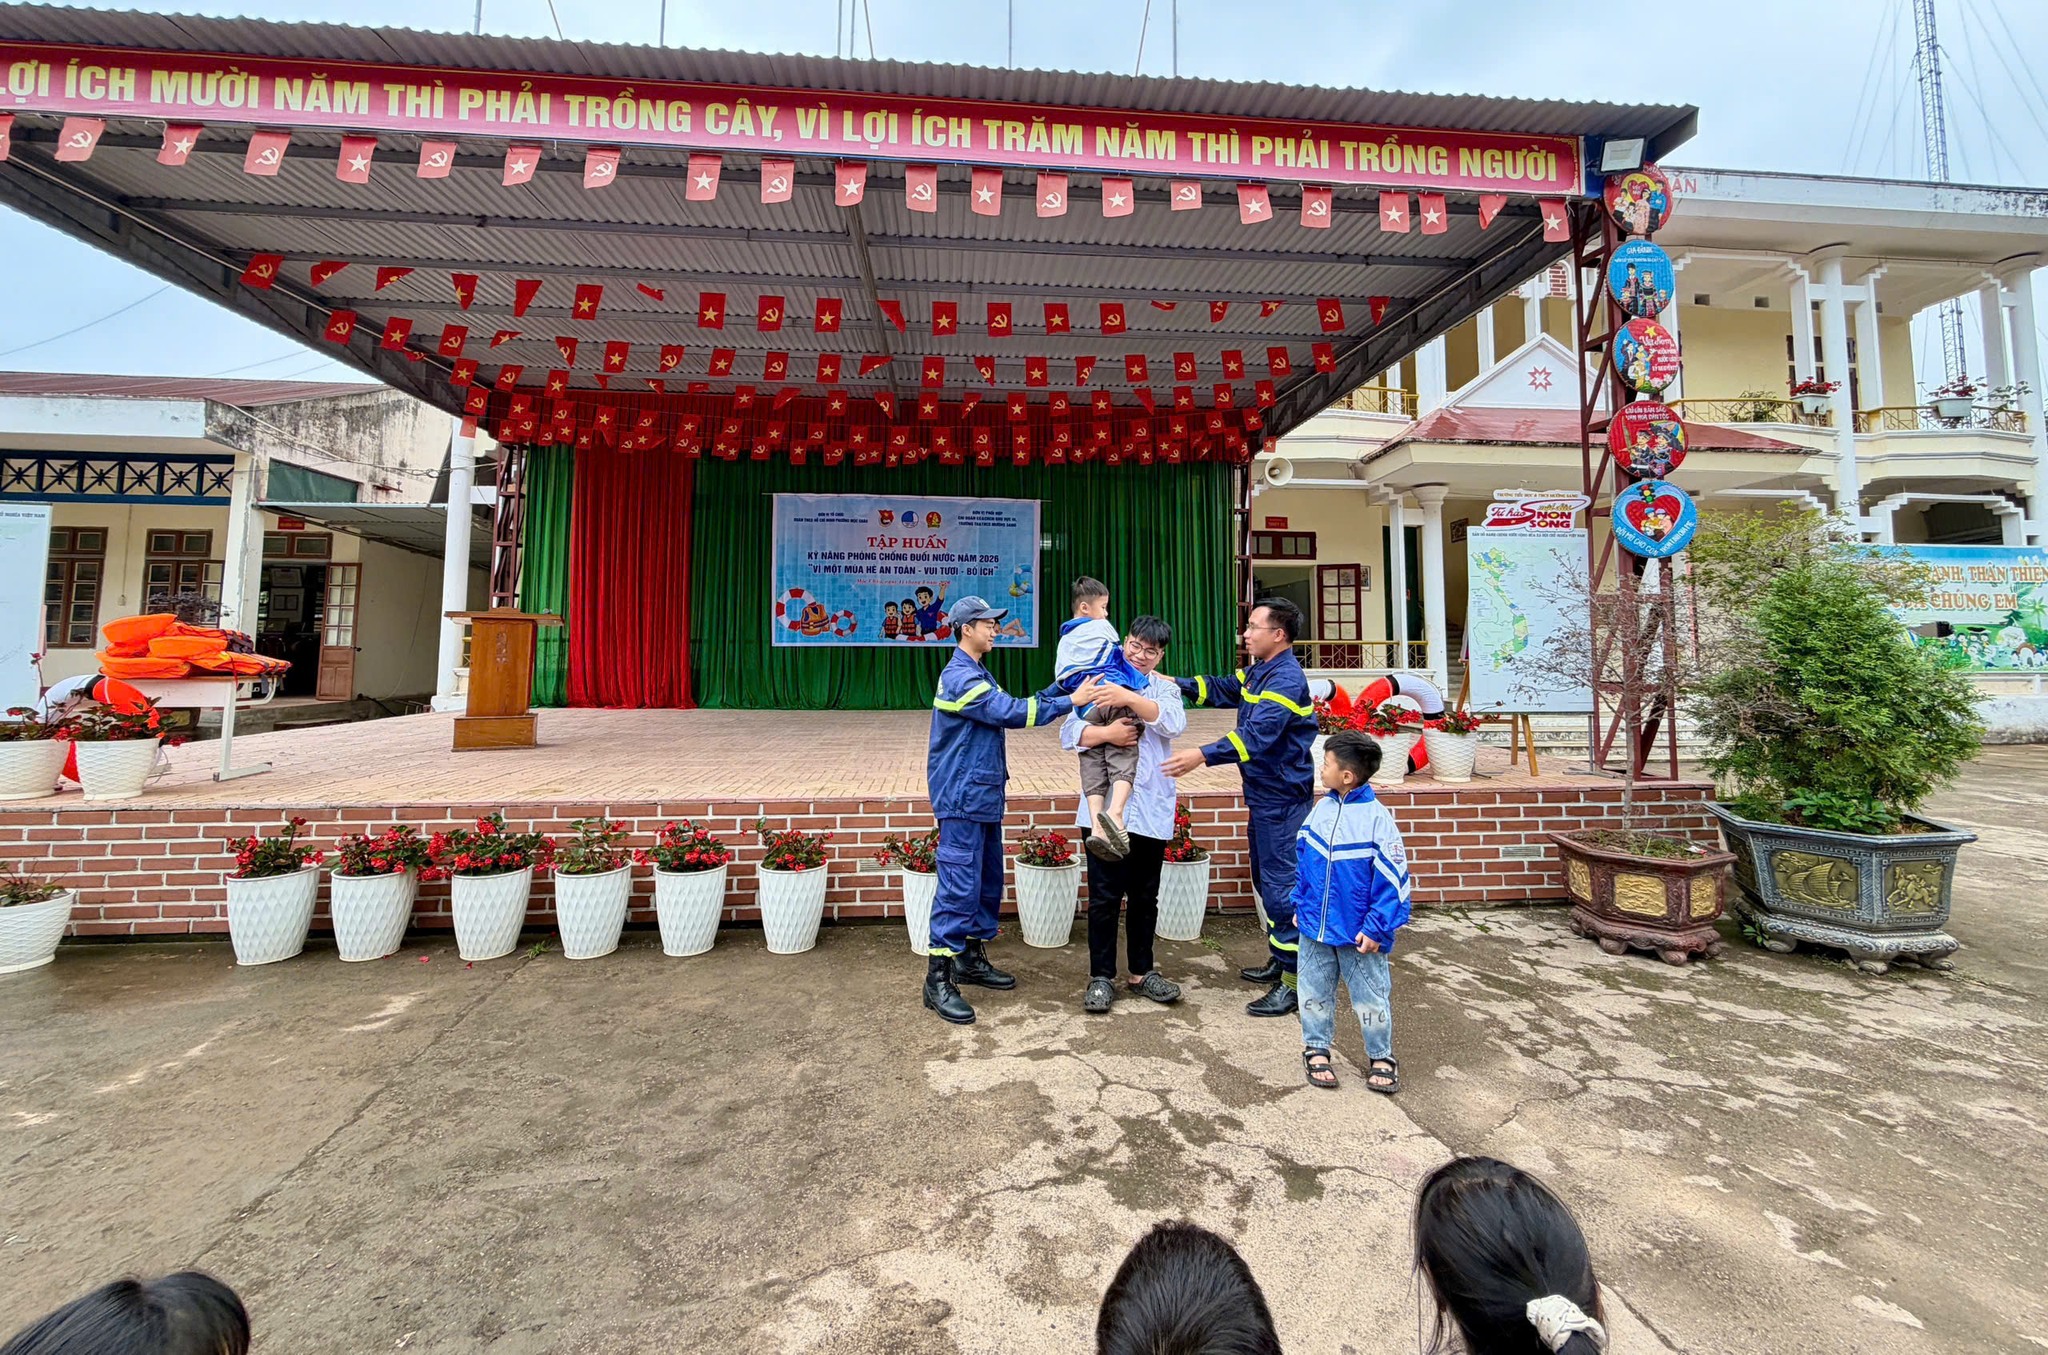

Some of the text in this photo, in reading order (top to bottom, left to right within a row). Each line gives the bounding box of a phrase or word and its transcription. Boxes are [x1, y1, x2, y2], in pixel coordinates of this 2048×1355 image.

[65, 58, 136, 102] ÍCH
[150, 66, 260, 109] MƯỜI
[274, 72, 370, 116] NĂM
[384, 77, 444, 119] THÌ
[458, 80, 550, 125] PHẢI
[564, 87, 692, 133] TRỒNG
[705, 98, 782, 142] CÂY,
[795, 102, 829, 140] VÌ
[842, 108, 898, 150] LỢI
[911, 107, 971, 148] ÍCH
[983, 116, 1083, 156] TRĂM
[1096, 122, 1176, 160] NĂM
[1187, 128, 1240, 164] THÌ
[1252, 129, 1328, 169] PHẢI
[1340, 134, 1447, 176] TRỒNG
[1460, 147, 1557, 182] NGƯỜI
[1671, 171, 1697, 193] ĂN
[1537, 511, 1571, 519] NON
[867, 534, 948, 550] TẬP HUẤN
[878, 550, 908, 562] CHỐNG
[979, 554, 1000, 563] 2026
[823, 563, 842, 576] MỘT
[879, 565, 891, 574] AN
[924, 566, 937, 575] VUI
[1928, 565, 1965, 582] ANH,
[1930, 589, 1991, 609] CHÚNG
[1994, 593, 2018, 609] EM
